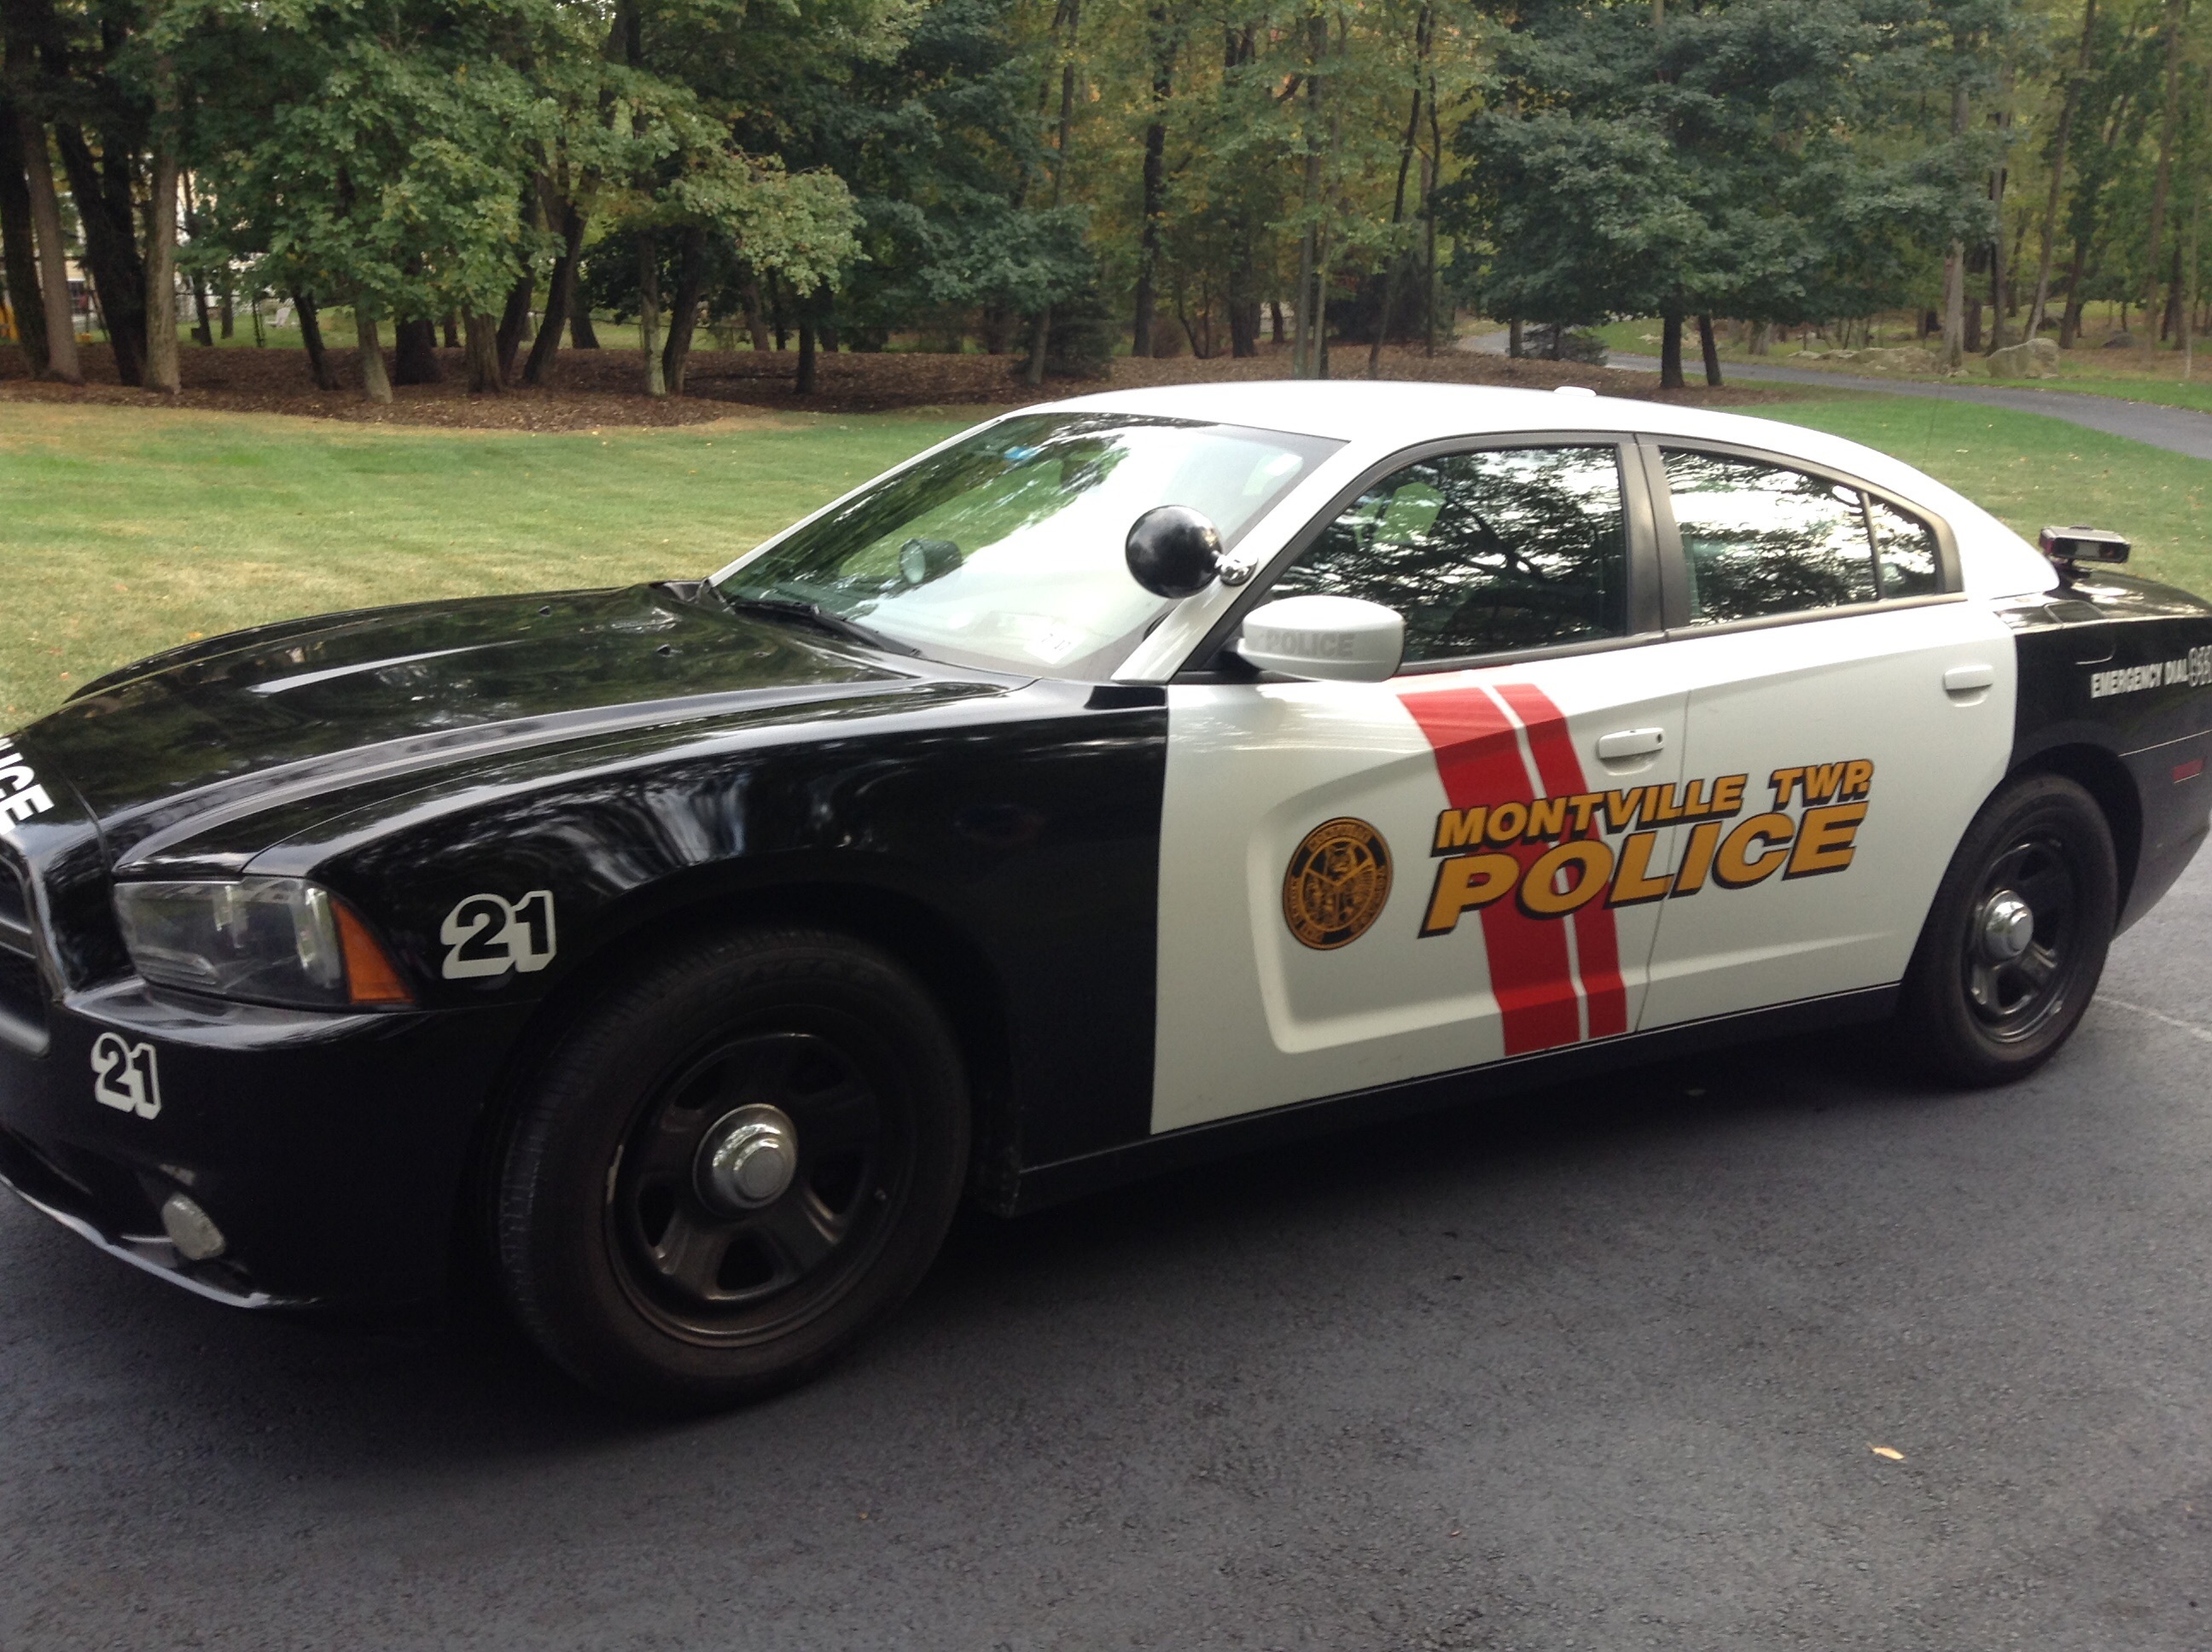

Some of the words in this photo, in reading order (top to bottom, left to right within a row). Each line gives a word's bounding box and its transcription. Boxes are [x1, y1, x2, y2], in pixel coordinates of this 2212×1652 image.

[1265, 628, 1355, 658] POLICE
[1430, 773, 1749, 858] MONTVILLE
[1417, 800, 1869, 939] POLICE
[440, 890, 557, 980] 21
[91, 1032, 161, 1120] 21
